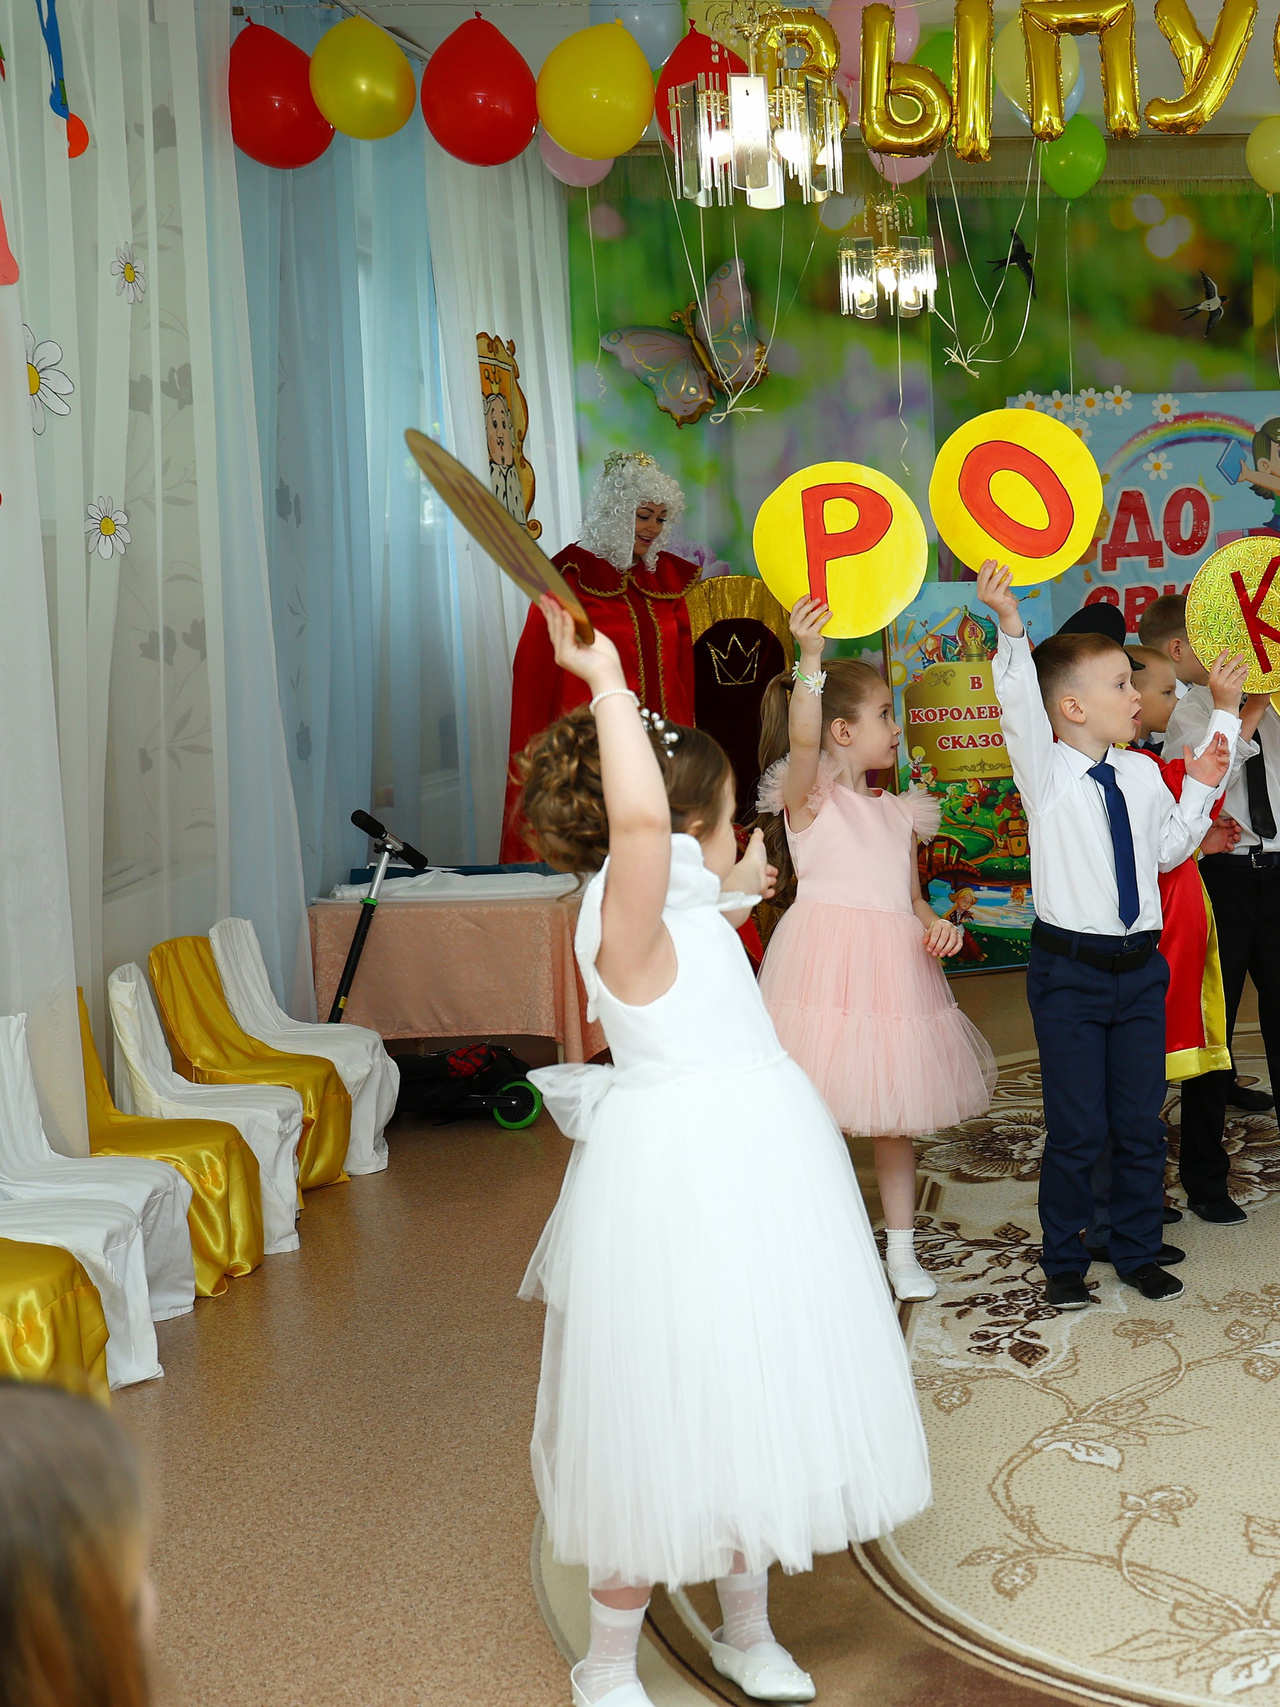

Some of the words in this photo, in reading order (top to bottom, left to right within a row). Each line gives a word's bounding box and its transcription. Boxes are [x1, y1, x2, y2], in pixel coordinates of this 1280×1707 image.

[958, 440, 1075, 559] О
[801, 482, 894, 613] Р
[1101, 485, 1212, 572] ДО
[970, 676, 983, 690] В
[910, 705, 1003, 724] КОРОЛЕВ
[938, 733, 1006, 750] СКАЗО
